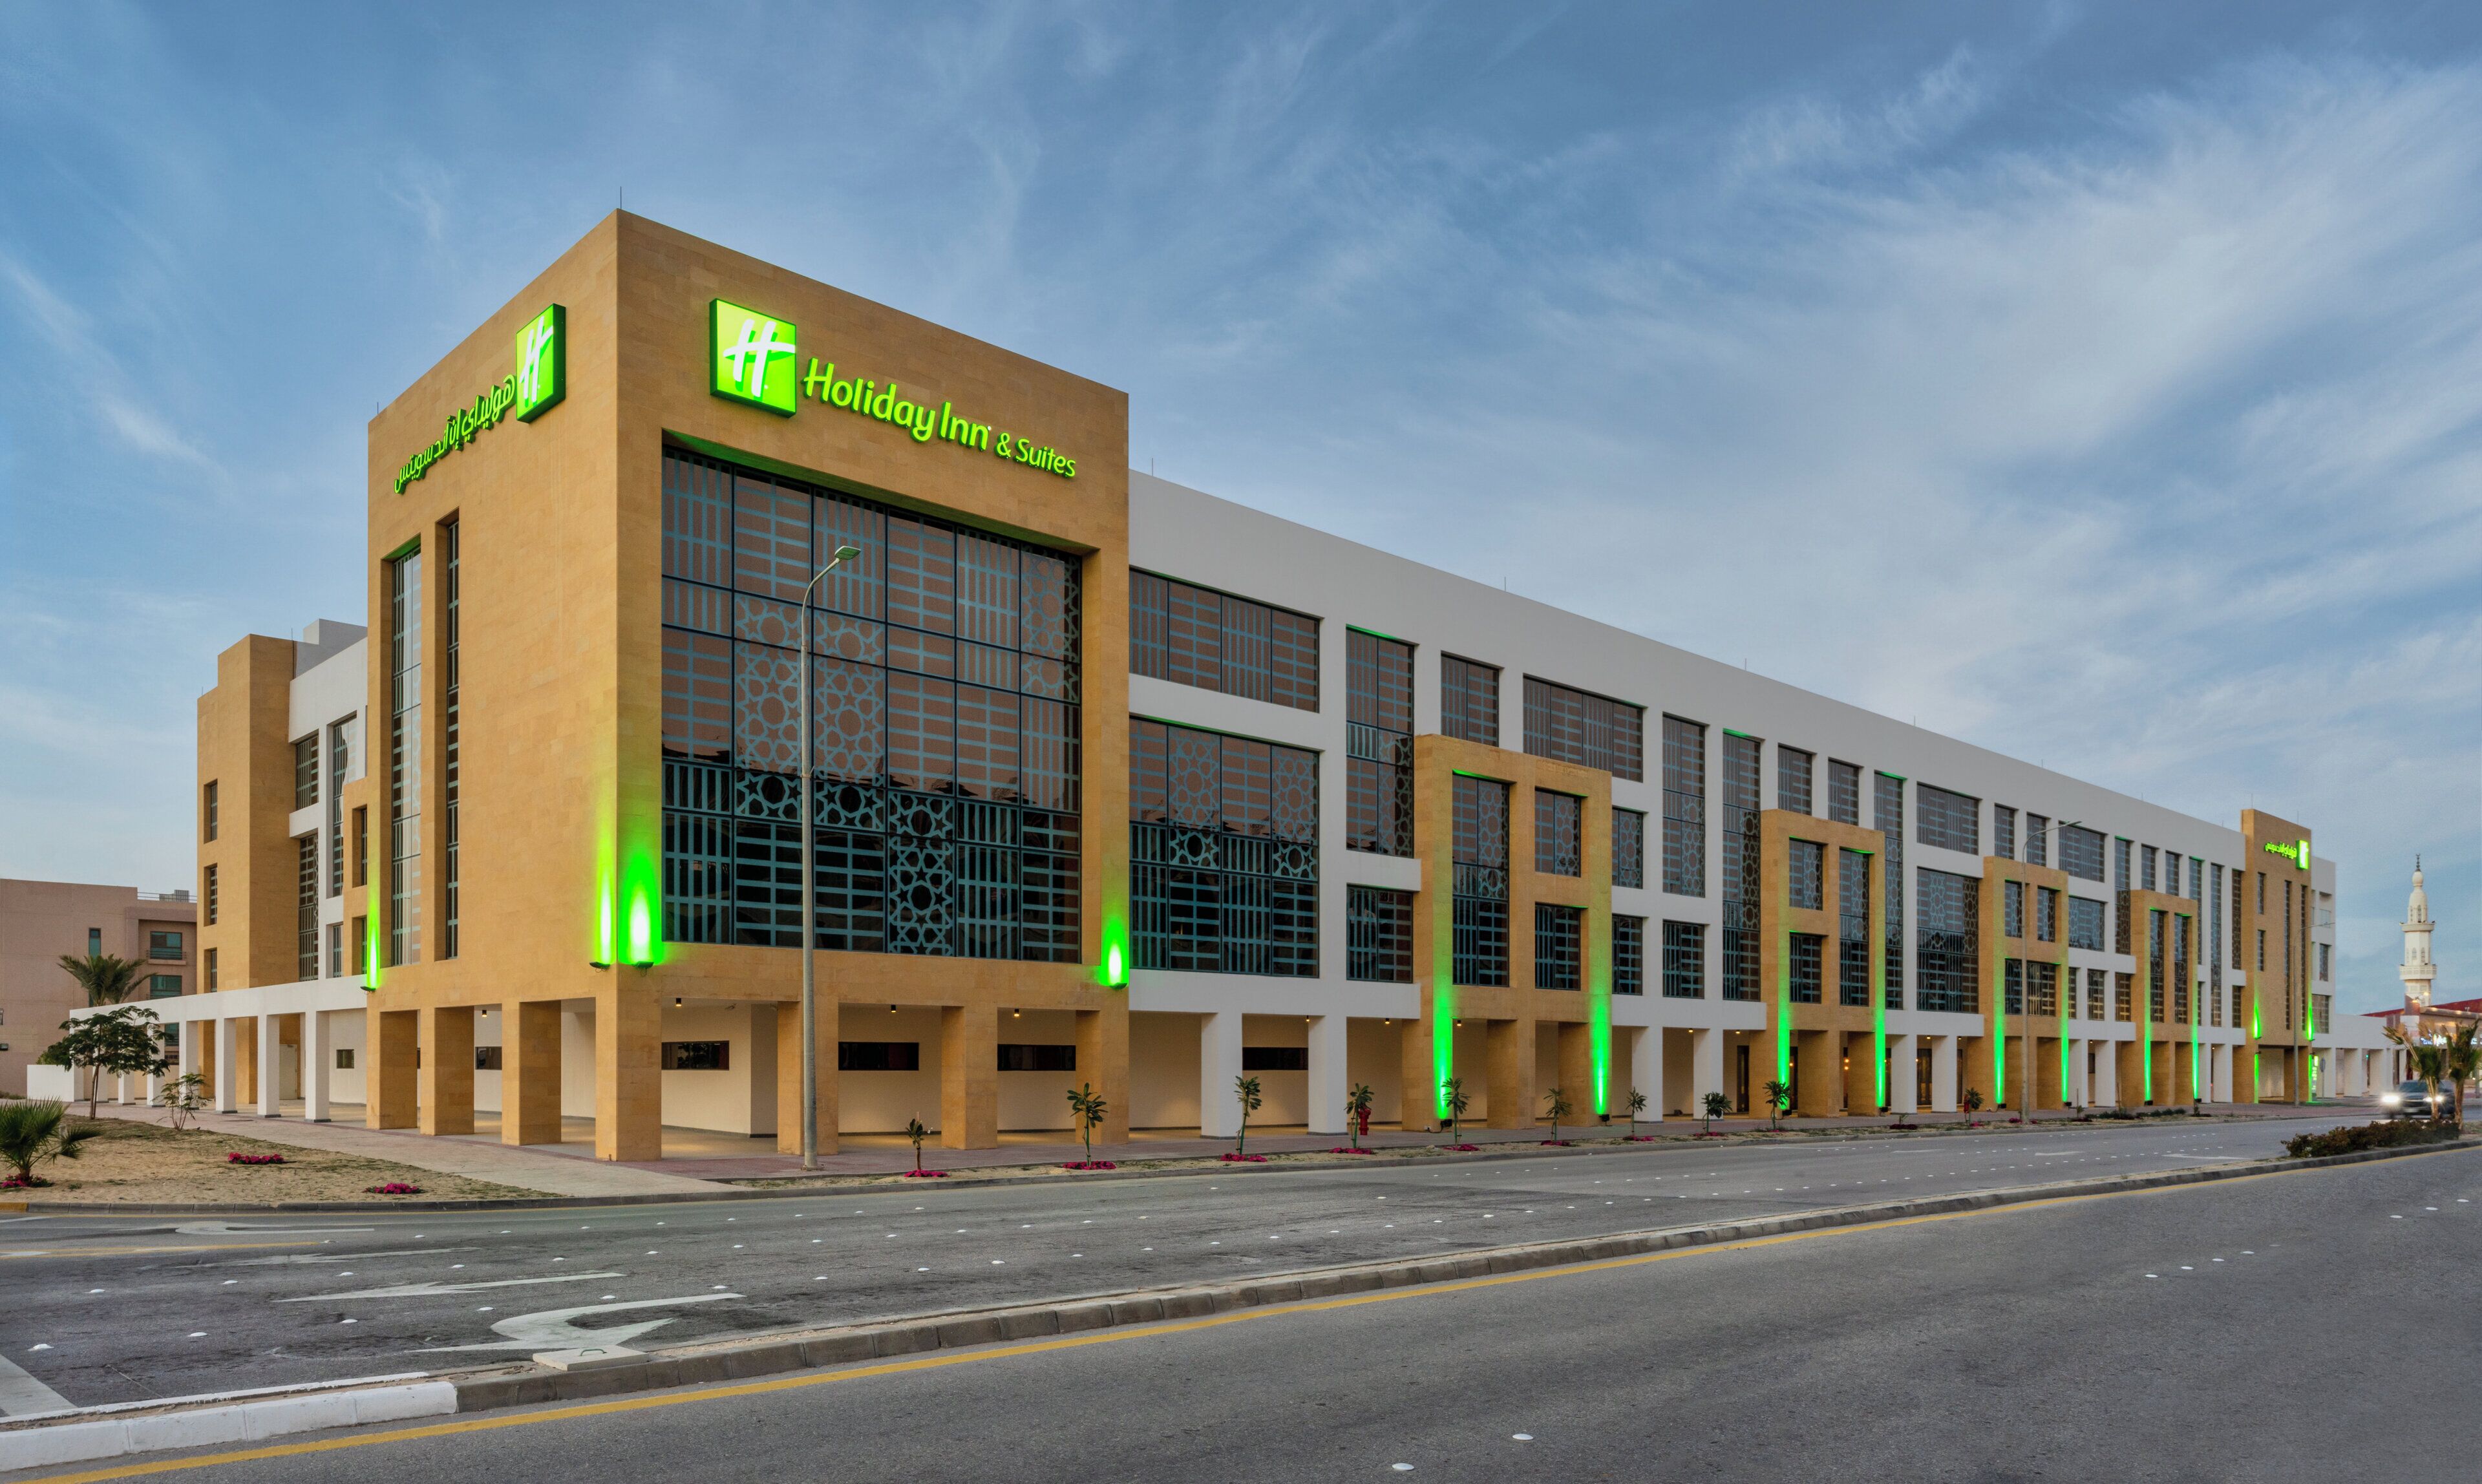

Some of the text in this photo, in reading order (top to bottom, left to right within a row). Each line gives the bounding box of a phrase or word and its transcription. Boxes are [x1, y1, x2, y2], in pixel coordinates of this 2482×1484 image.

[449, 408, 461, 450] إن
[461, 373, 515, 443] هوليداي
[803, 357, 1076, 477] Holiday Inn & Suites
[394, 444, 433, 494] سويتس
